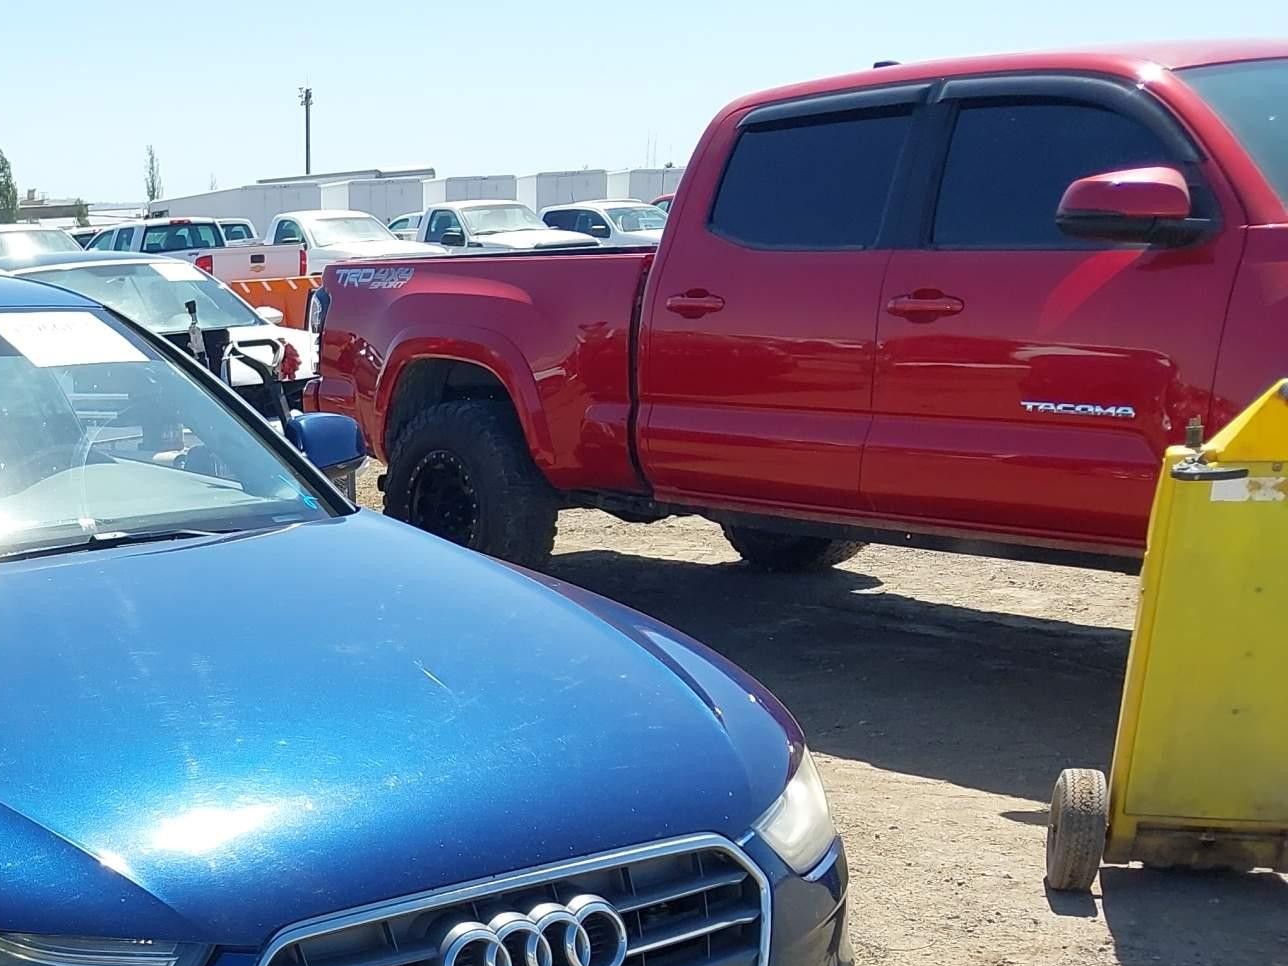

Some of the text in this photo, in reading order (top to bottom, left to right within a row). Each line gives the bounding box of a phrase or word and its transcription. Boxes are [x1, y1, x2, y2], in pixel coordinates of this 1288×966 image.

[336, 268, 375, 288] TRD
[368, 281, 408, 289] SPORT
[1020, 401, 1136, 418] TACOMA
